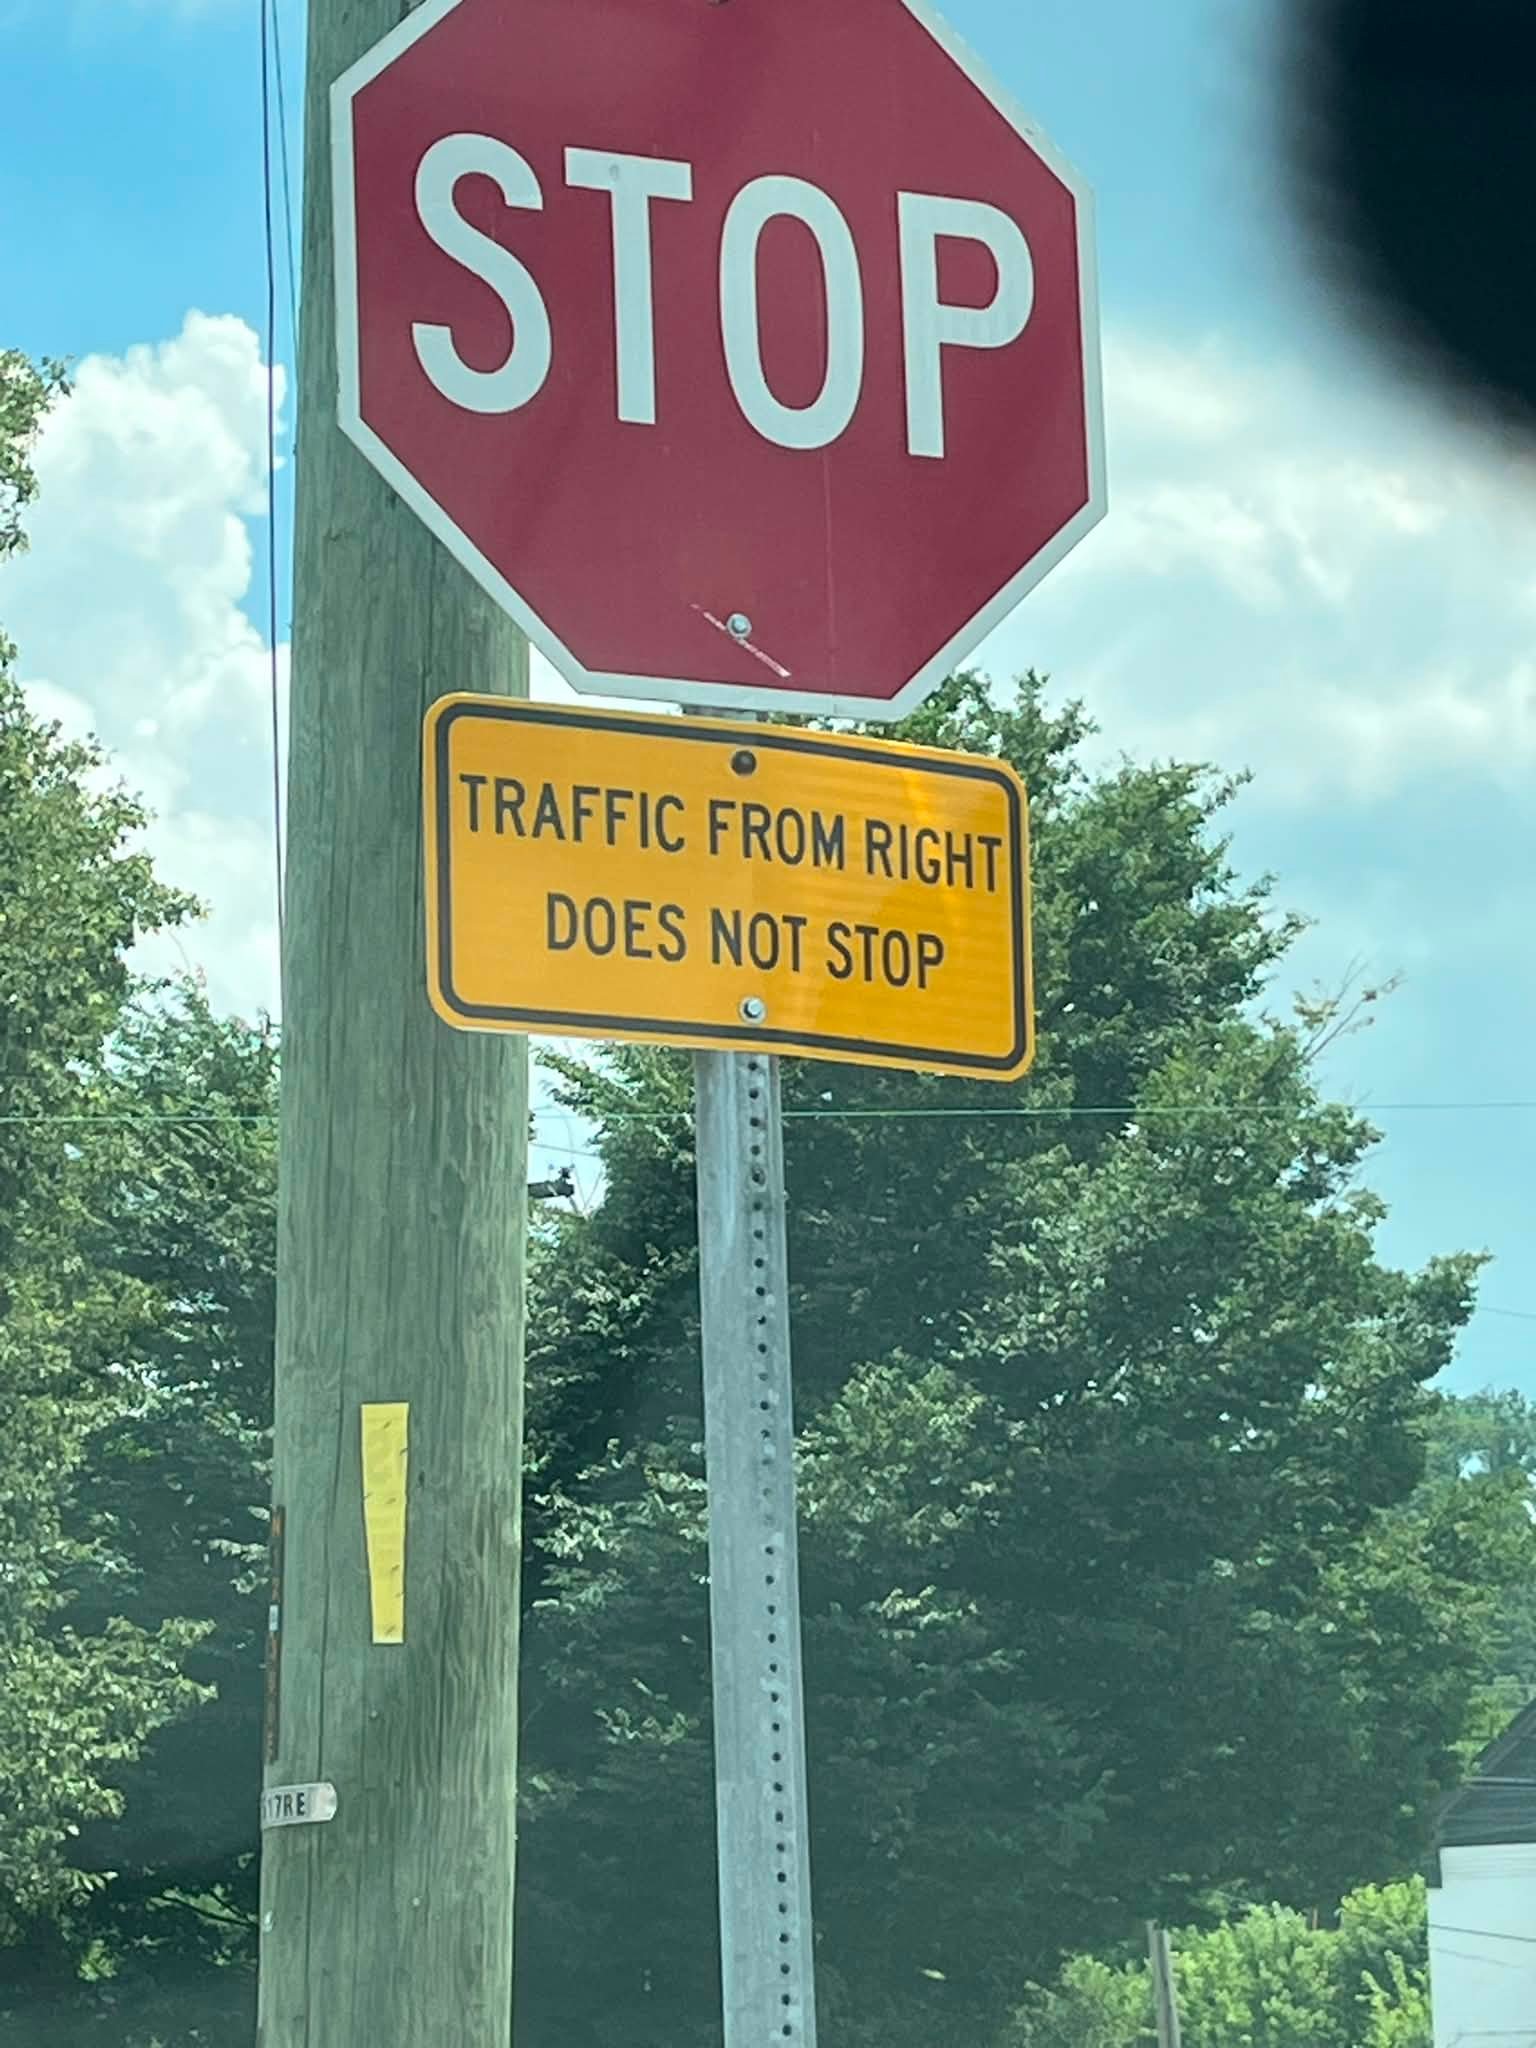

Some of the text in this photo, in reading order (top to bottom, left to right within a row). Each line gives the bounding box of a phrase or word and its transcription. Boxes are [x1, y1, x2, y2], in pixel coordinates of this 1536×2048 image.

[412, 133, 1034, 459] STOP
[458, 773, 1003, 893] TRAFFIC FROM RIGHT
[547, 892, 945, 990] DOES NOT STOP
